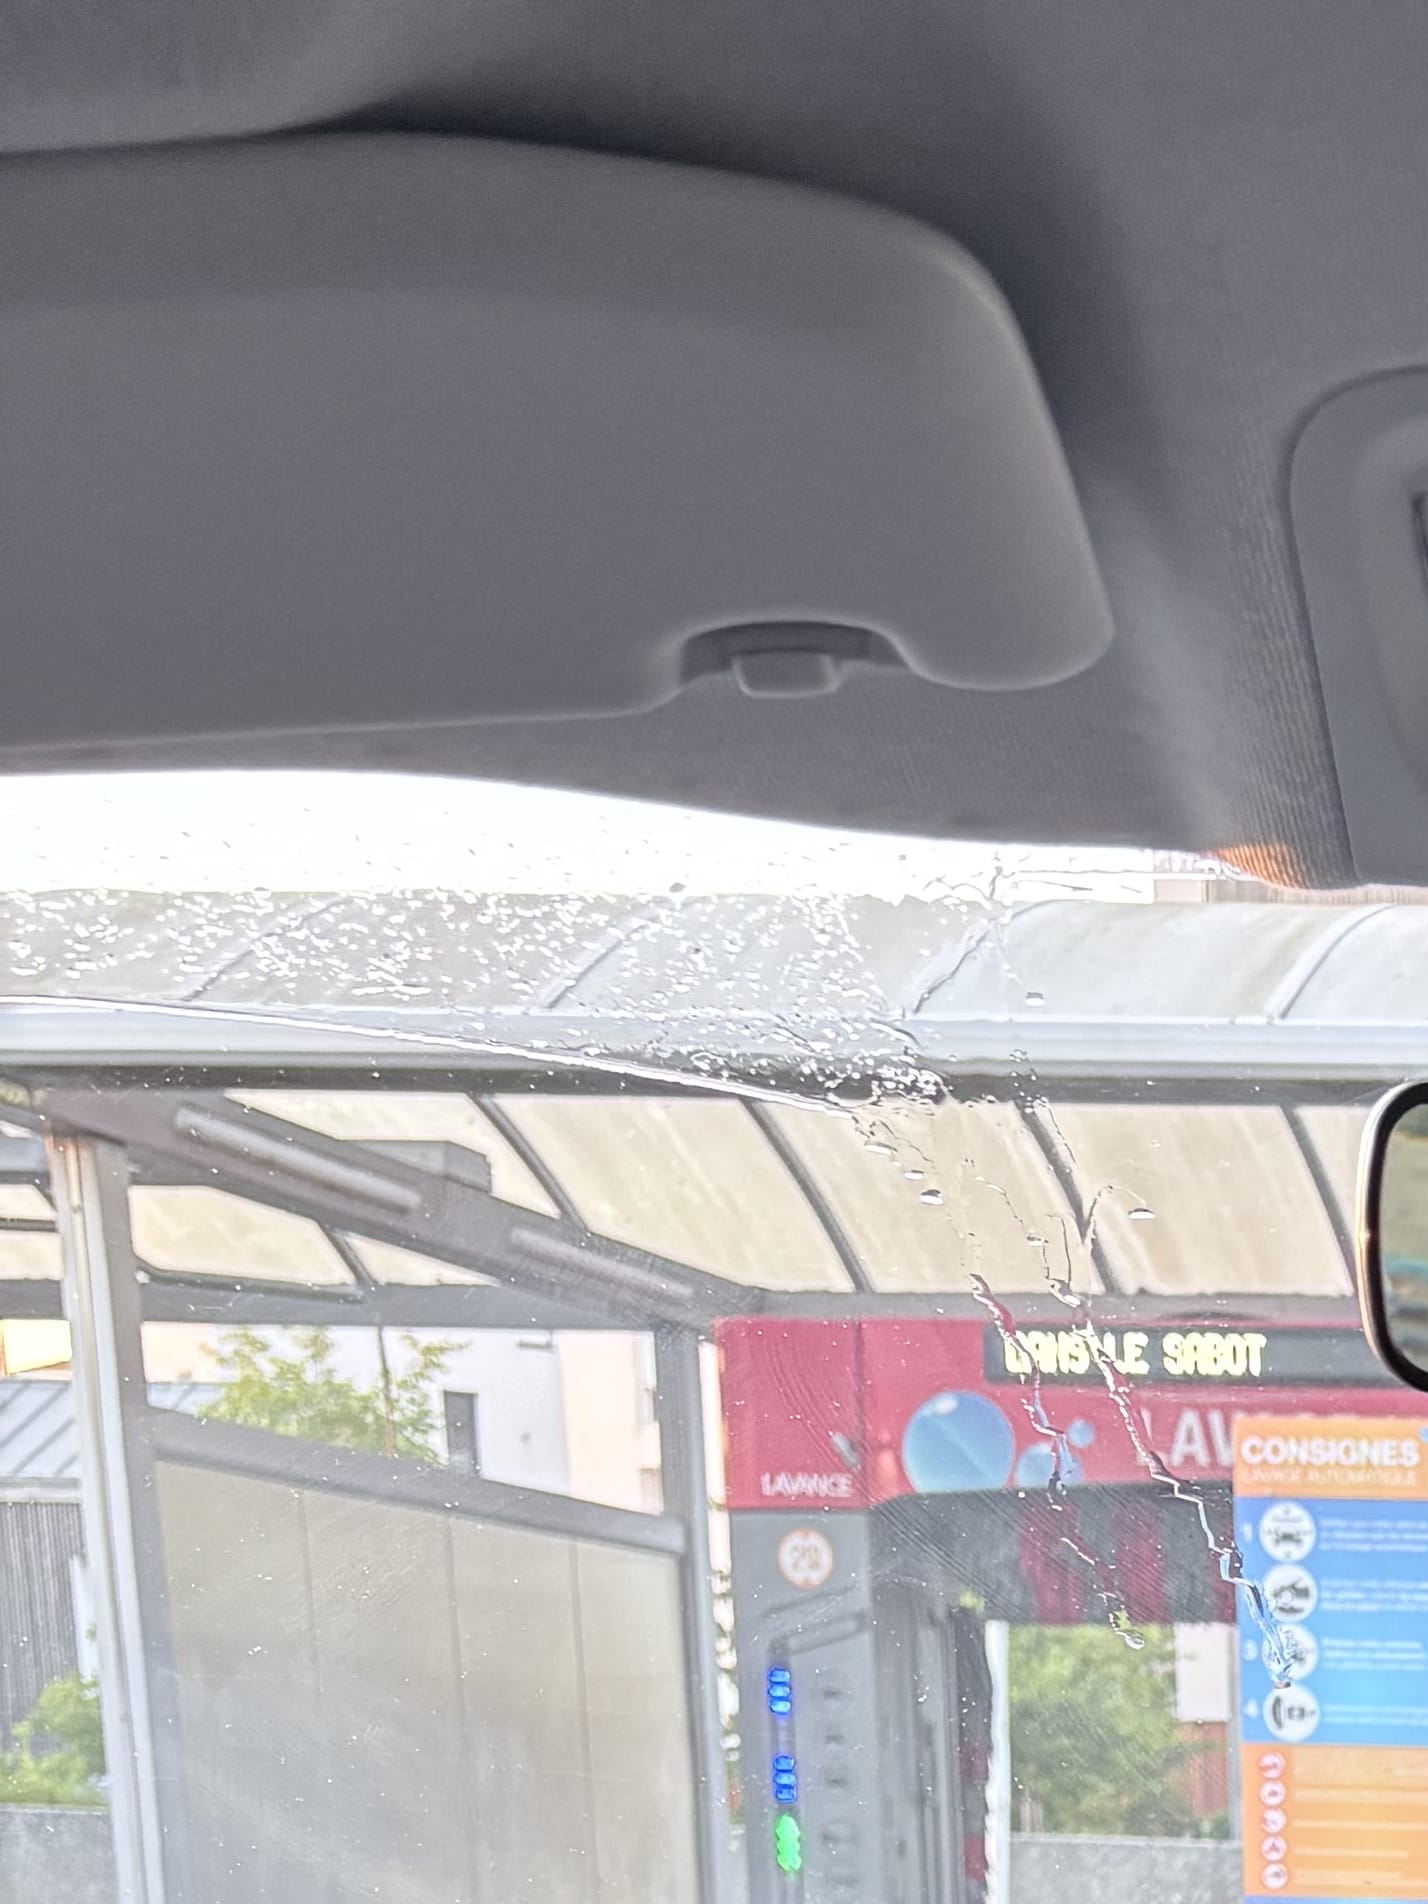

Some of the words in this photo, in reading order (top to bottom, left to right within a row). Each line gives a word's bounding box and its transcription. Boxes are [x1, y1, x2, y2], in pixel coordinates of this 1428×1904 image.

[1162, 1331, 1267, 1376] SABOT
[1239, 1434, 1421, 1467] CONSIGNES
[760, 1471, 855, 1498] LAVANCE
